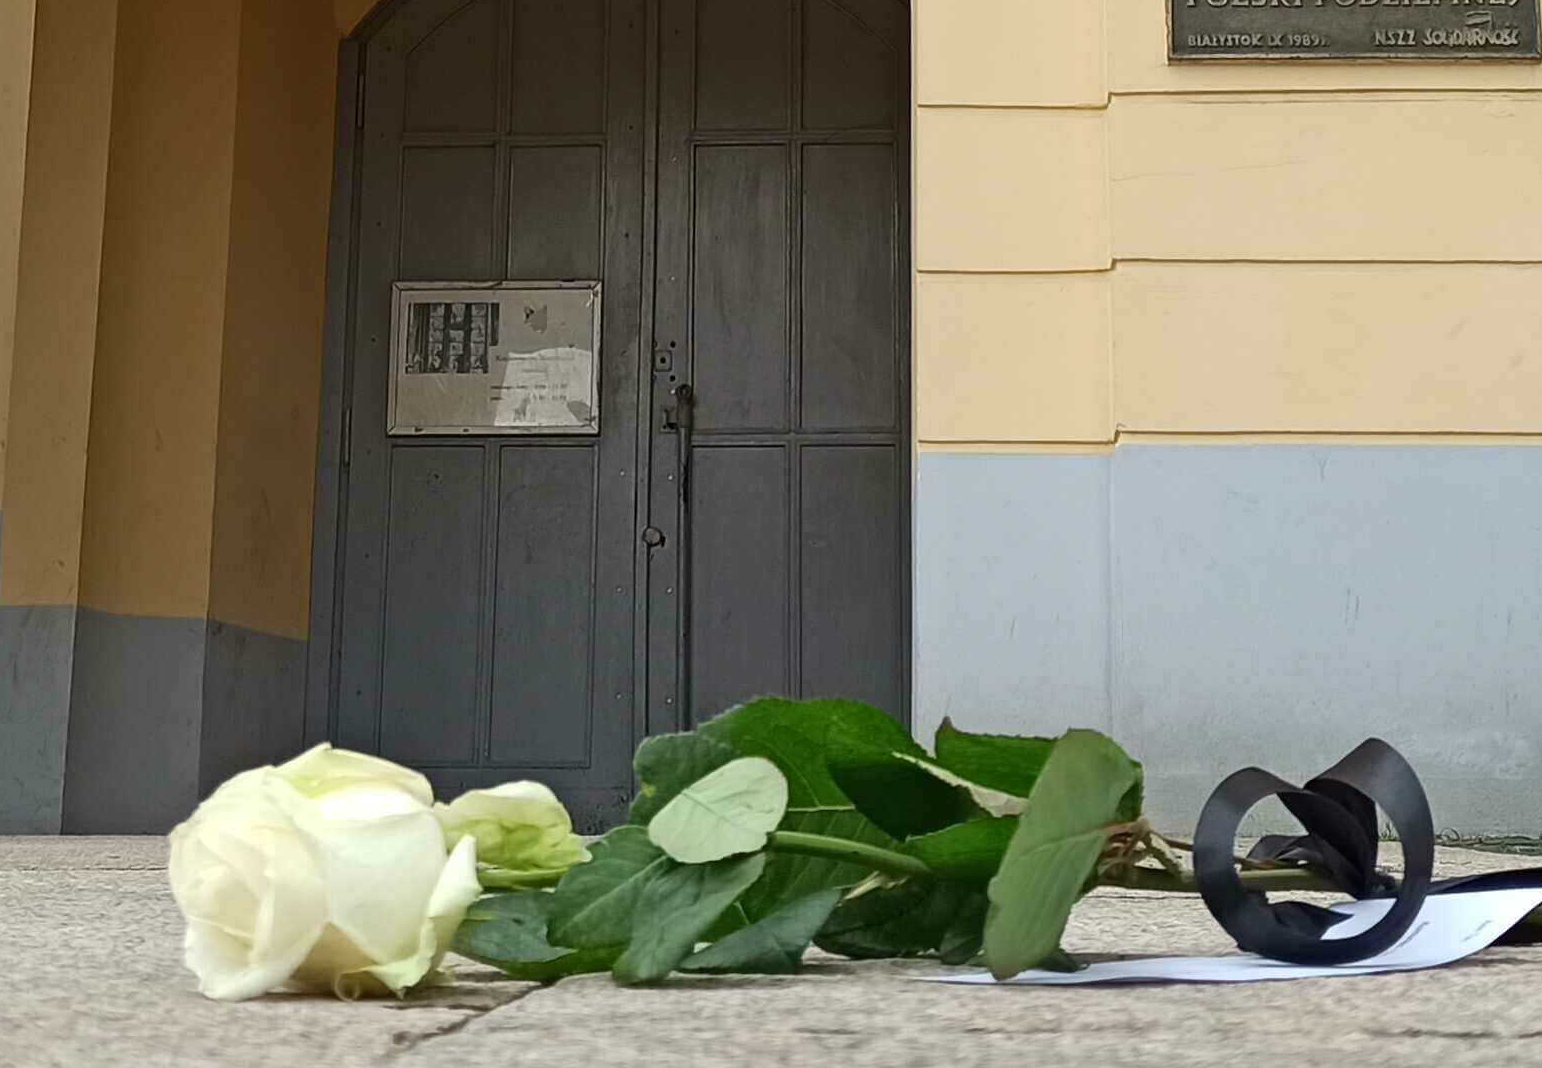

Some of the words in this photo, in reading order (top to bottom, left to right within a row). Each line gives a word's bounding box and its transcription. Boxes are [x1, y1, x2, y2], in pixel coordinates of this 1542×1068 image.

[1188, 33, 1263, 47] BIAŁYSTOK
[1268, 33, 1284, 46] IX
[1375, 29, 1416, 45] NSZZ
